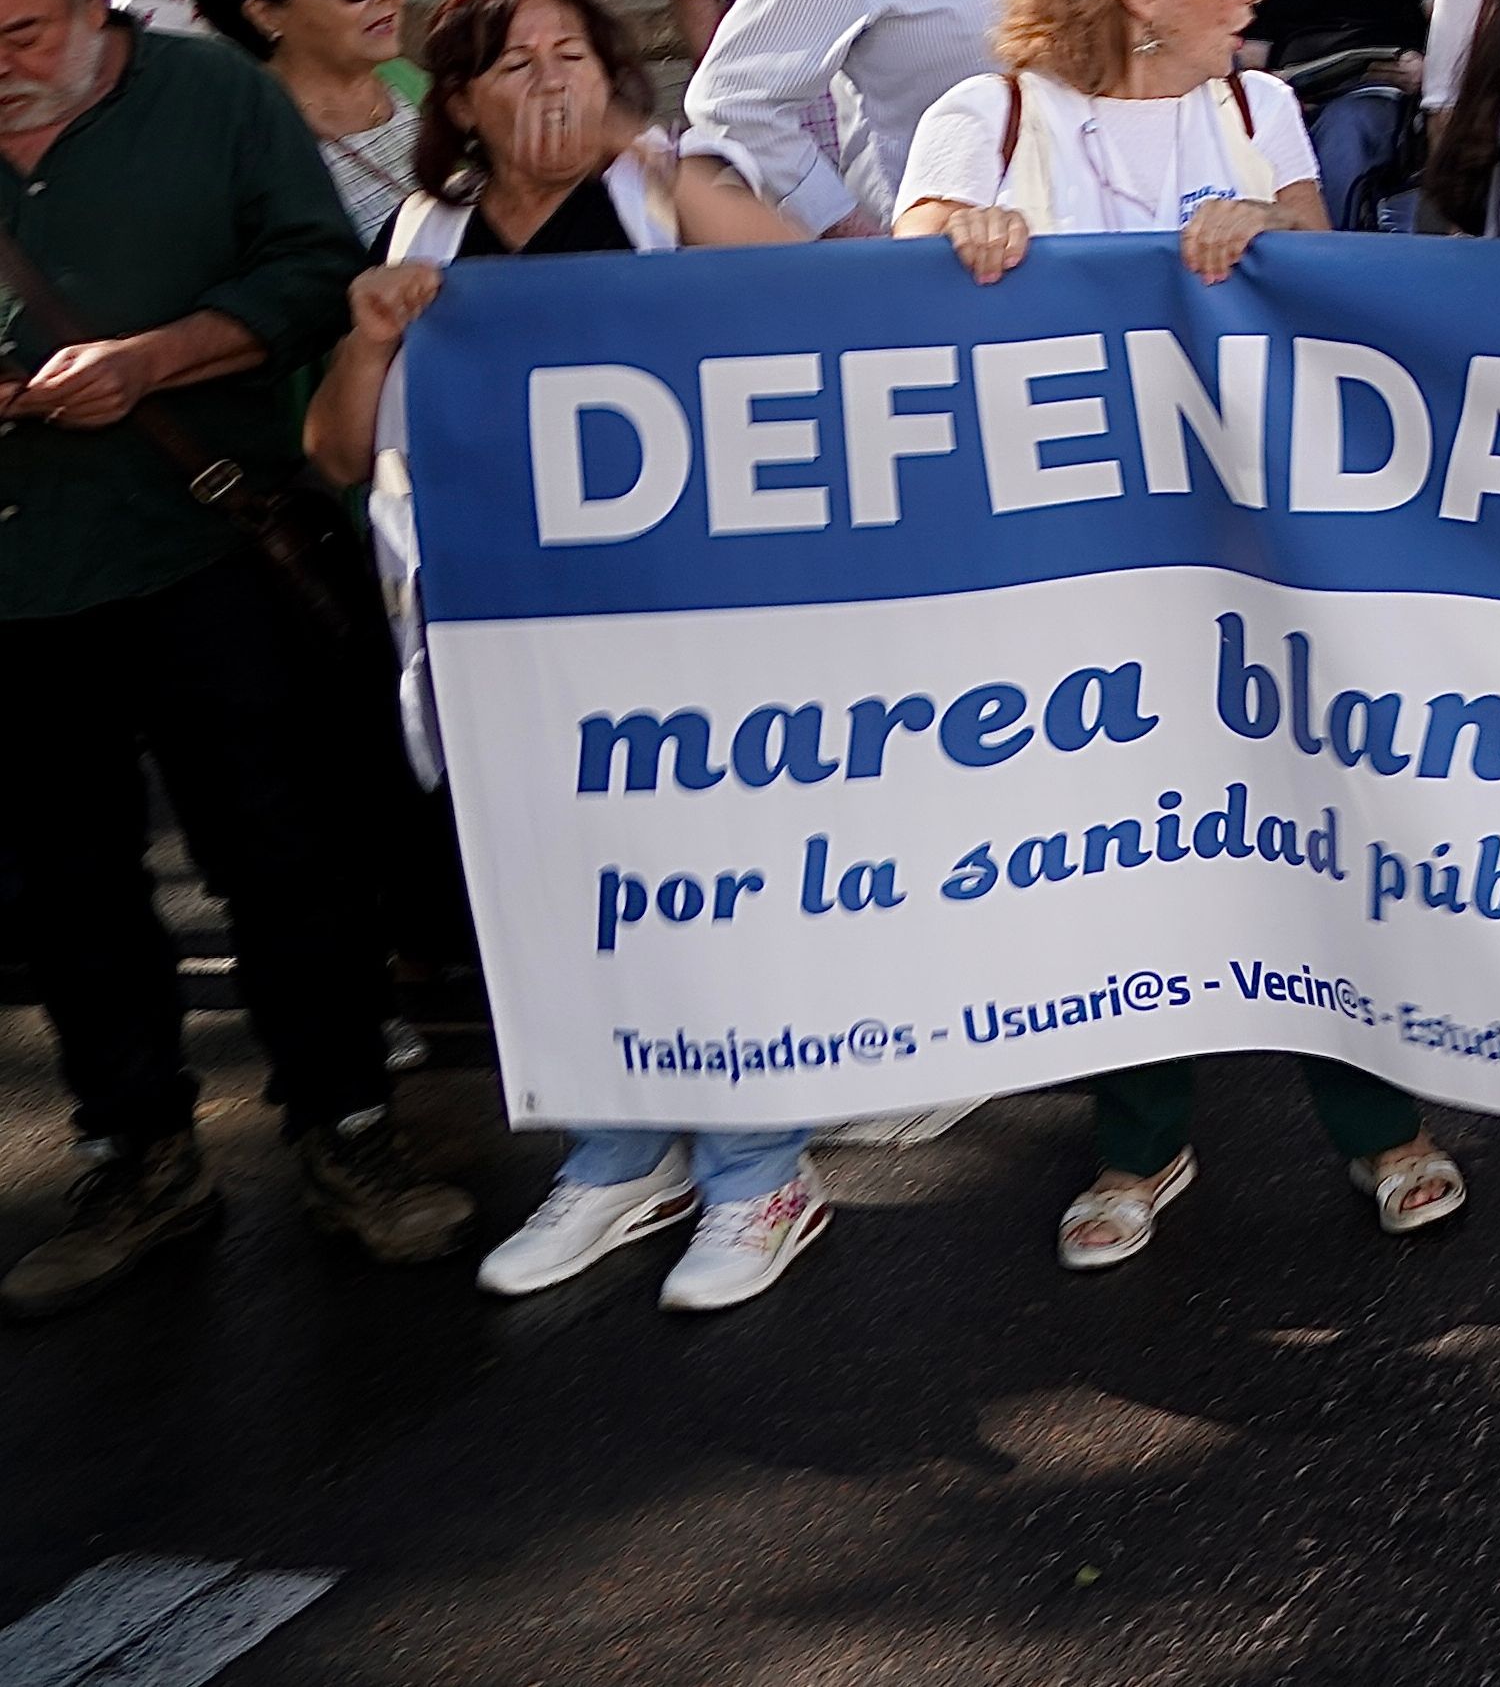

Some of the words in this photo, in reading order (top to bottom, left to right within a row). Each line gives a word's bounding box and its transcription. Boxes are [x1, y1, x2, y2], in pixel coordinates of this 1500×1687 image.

[577, 662, 1159, 794] marea
[597, 867, 764, 953] por
[801, 834, 906, 915] la
[940, 782, 1345, 901] sanidad
[614, 1021, 916, 1084] Trabajador@s
[964, 972, 1190, 1043] Usuari@s
[1230, 962, 1375, 1026] Vecin@s
